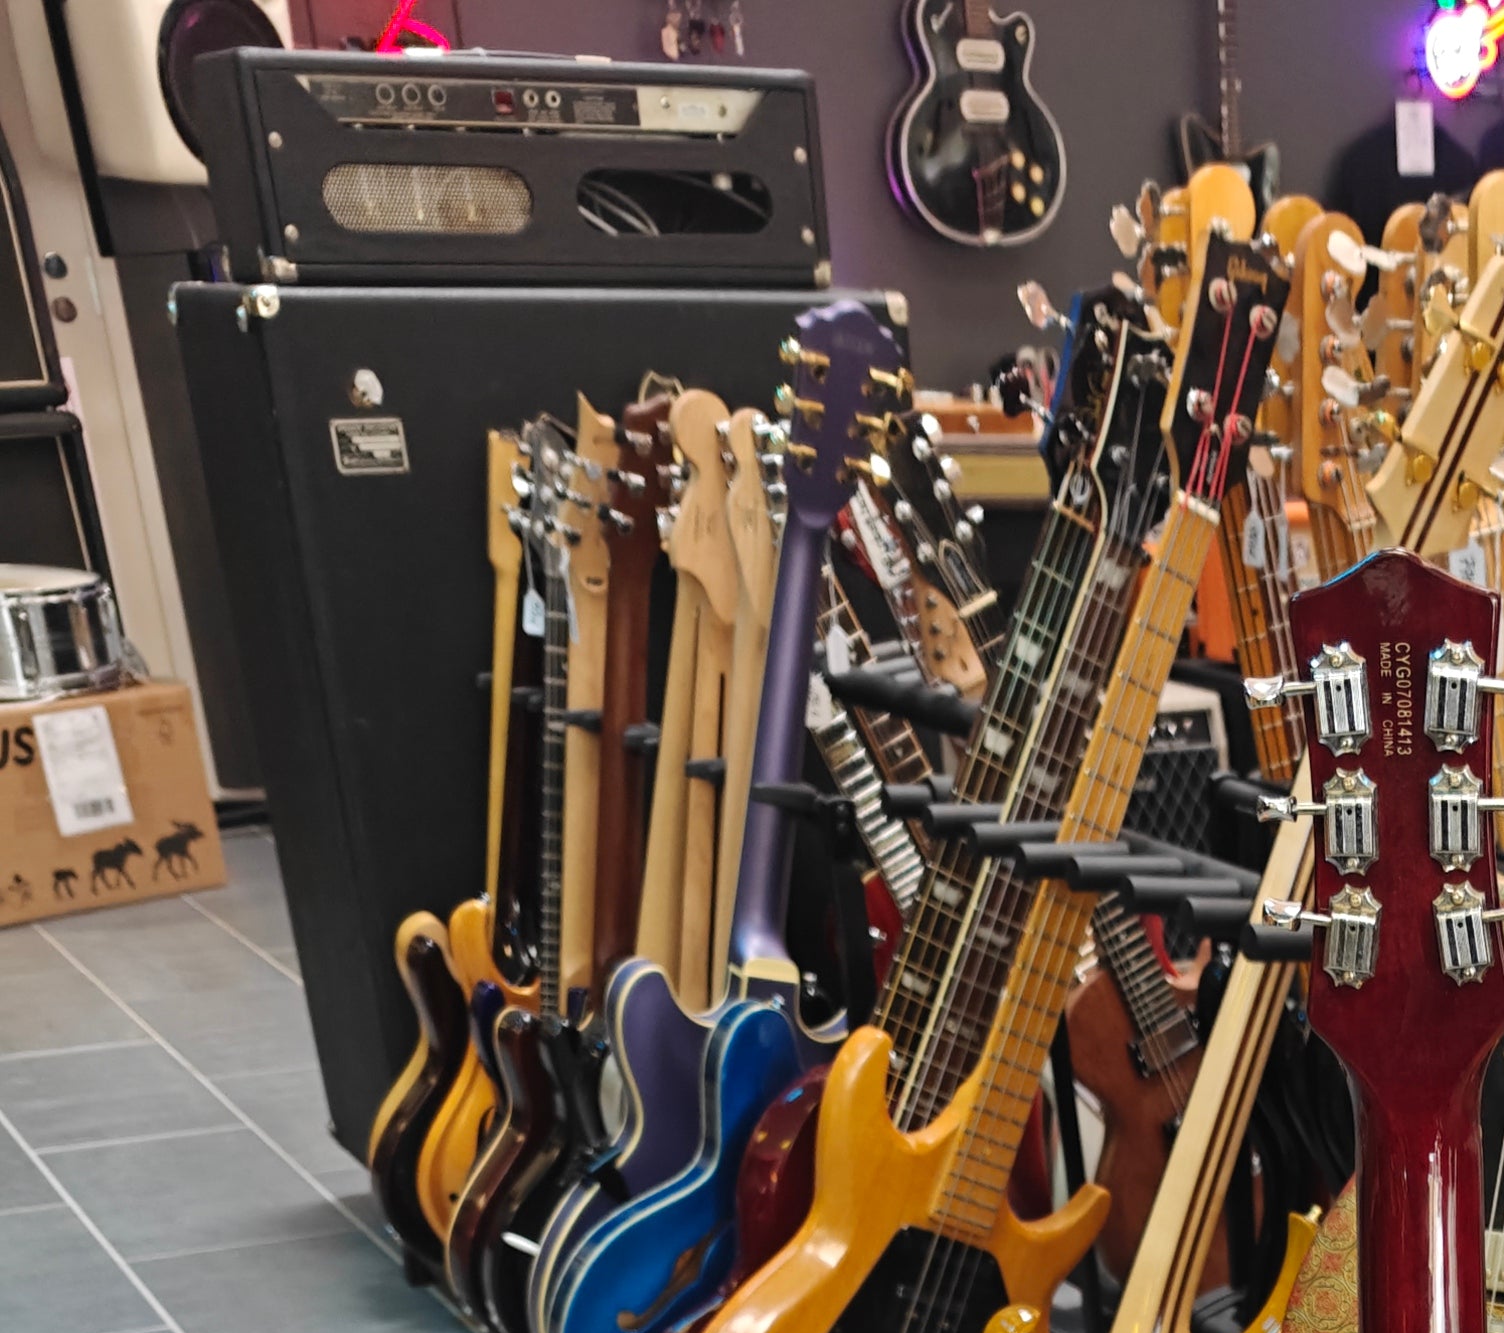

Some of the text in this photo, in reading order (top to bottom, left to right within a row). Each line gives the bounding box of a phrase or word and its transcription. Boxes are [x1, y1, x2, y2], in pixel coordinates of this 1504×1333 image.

[1380, 642, 1395, 757] MADE IN CHINA
[1395, 642, 1413, 756] CYG07081413
